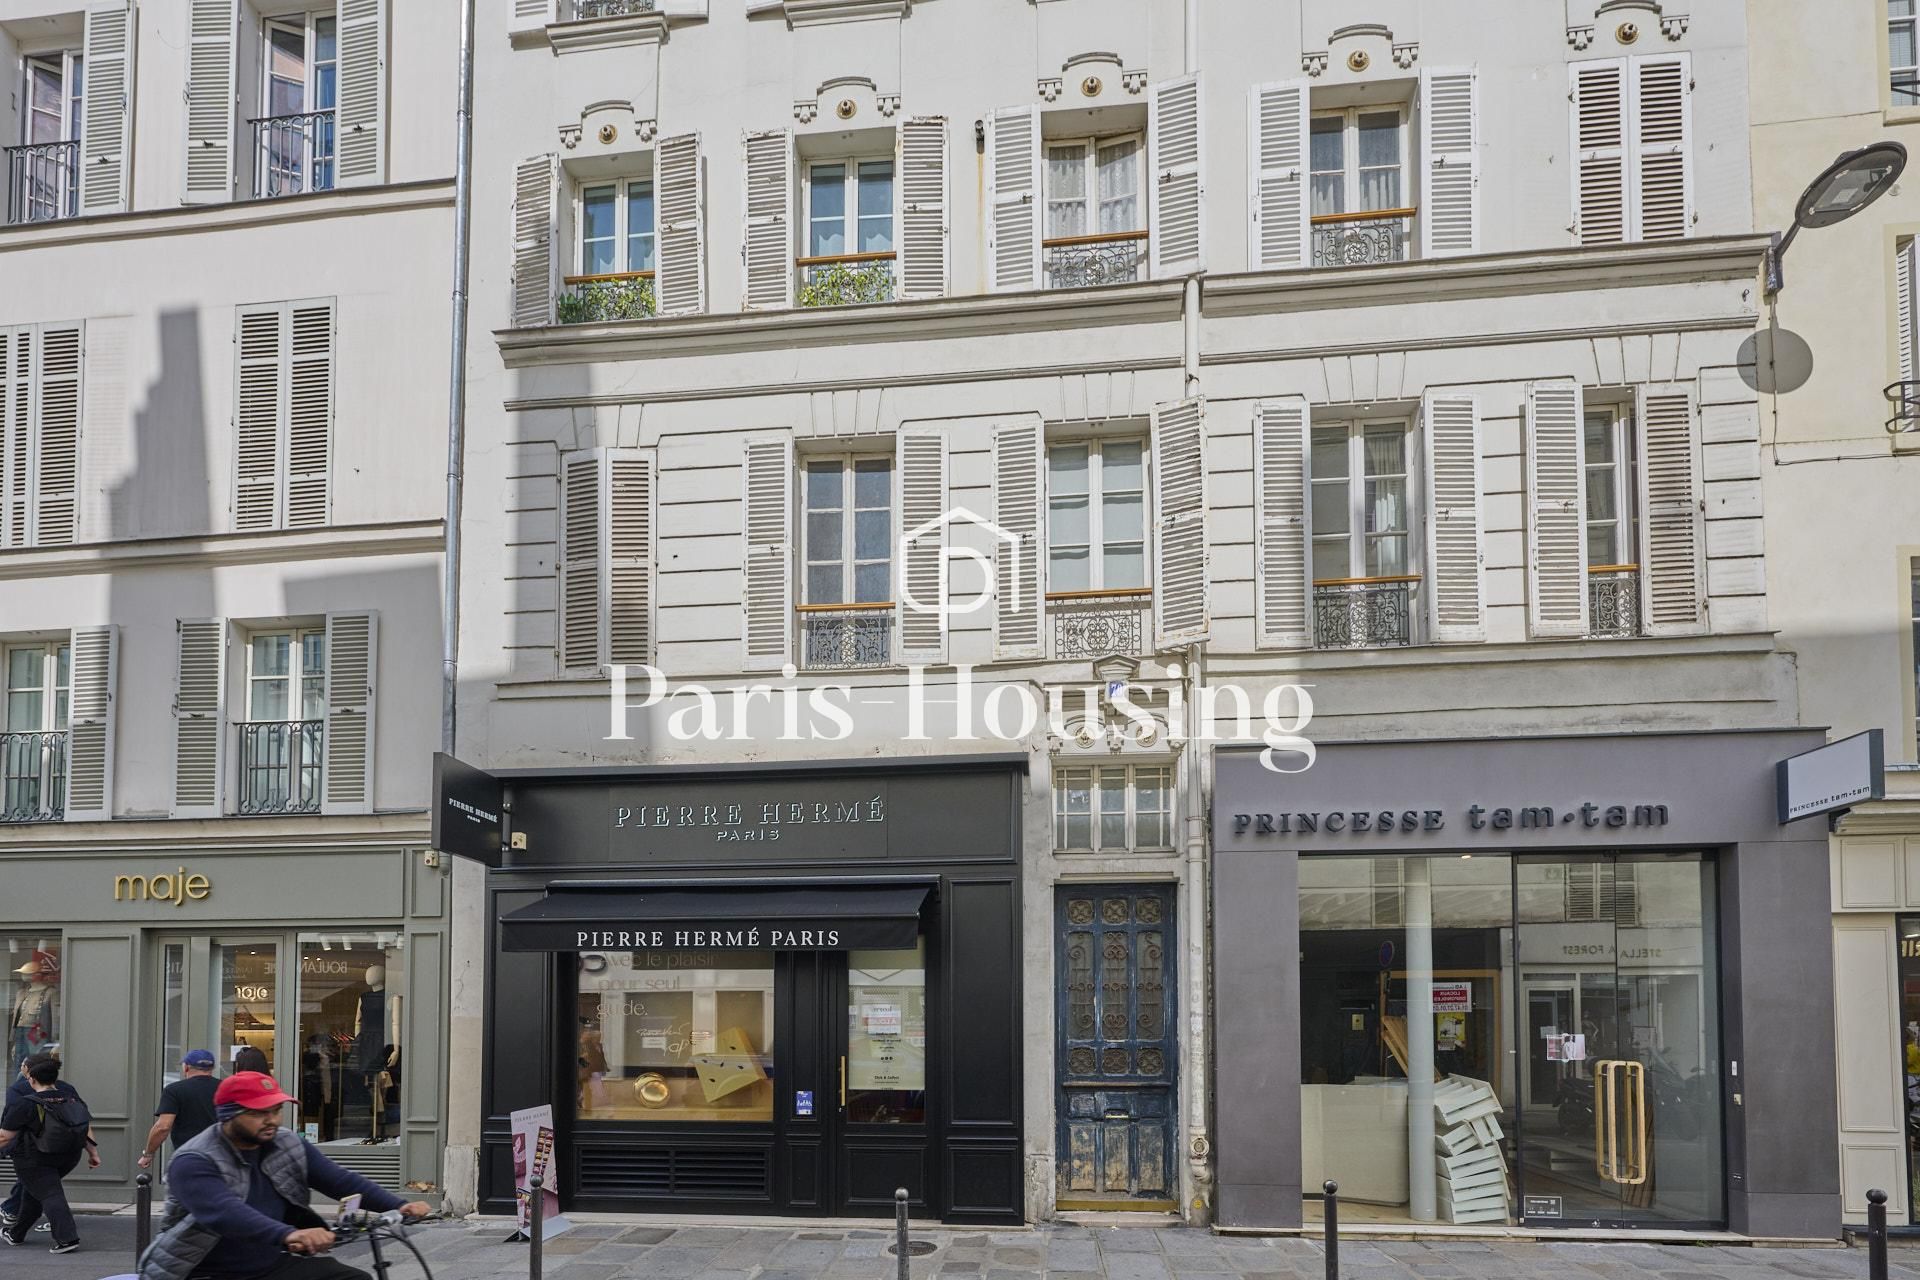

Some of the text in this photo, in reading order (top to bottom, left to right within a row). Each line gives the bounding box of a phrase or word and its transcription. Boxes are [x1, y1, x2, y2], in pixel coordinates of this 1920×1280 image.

[448, 797, 498, 823] PIERRE HERMÉ
[614, 795, 885, 828] PIERRE HERMÉ
[1789, 798, 1829, 813] PRINCESSE
[1234, 810, 1445, 834] PRINCESSE
[716, 829, 780, 841] PARIS
[114, 866, 210, 906] maje
[576, 927, 840, 947] PIERRE HERMÉ PARIS
[602, 951, 715, 969] Avec le plaisir
[598, 976, 681, 991] pour seul
